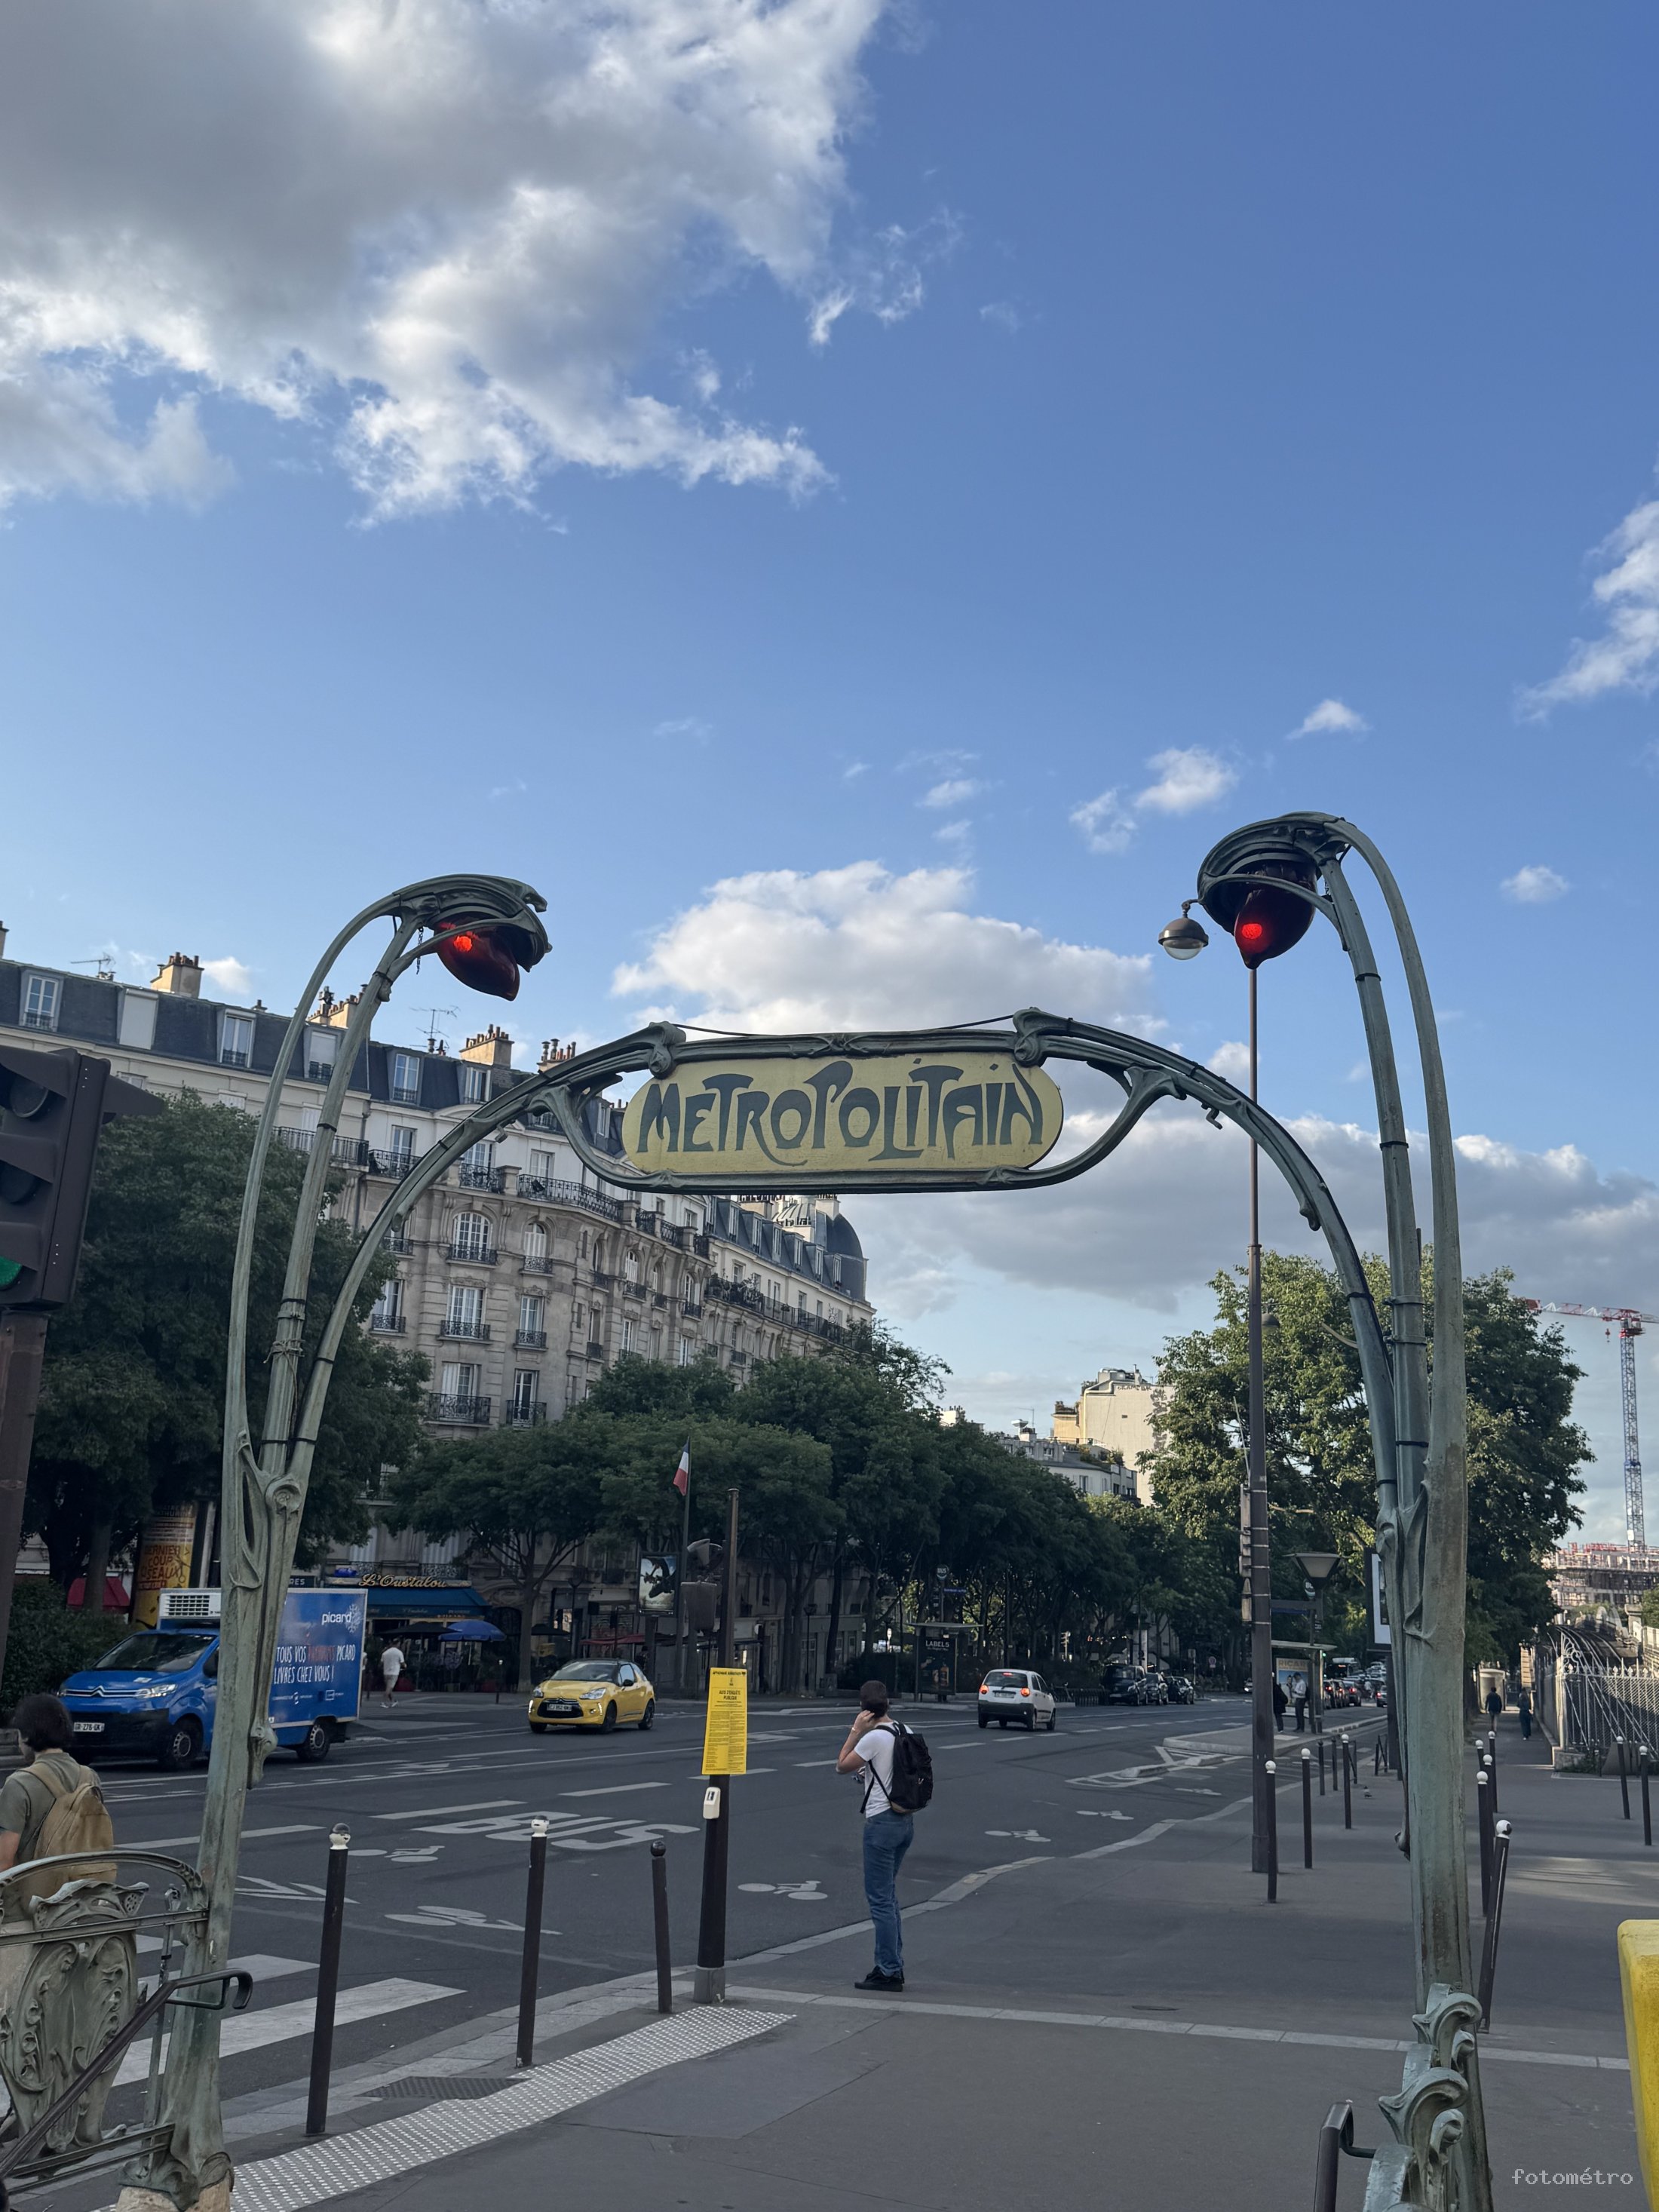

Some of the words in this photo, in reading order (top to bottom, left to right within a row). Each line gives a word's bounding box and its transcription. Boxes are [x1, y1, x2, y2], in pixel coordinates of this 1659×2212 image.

[636, 1057, 1043, 1167] METROPOLITAIN
[148, 1555, 173, 1568] COUP
[358, 1572, 447, 1588] L'Oustalou
[321, 1611, 352, 1626] picard
[277, 1646, 293, 1664] TOUS
[295, 1646, 307, 1663] VOS
[336, 1643, 356, 1661] PICARD
[274, 1664, 295, 1685] LIVRÉS
[297, 1665, 312, 1683] CHEZ
[314, 1664, 330, 1683] VOUS
[410, 1809, 701, 1851] BUS
